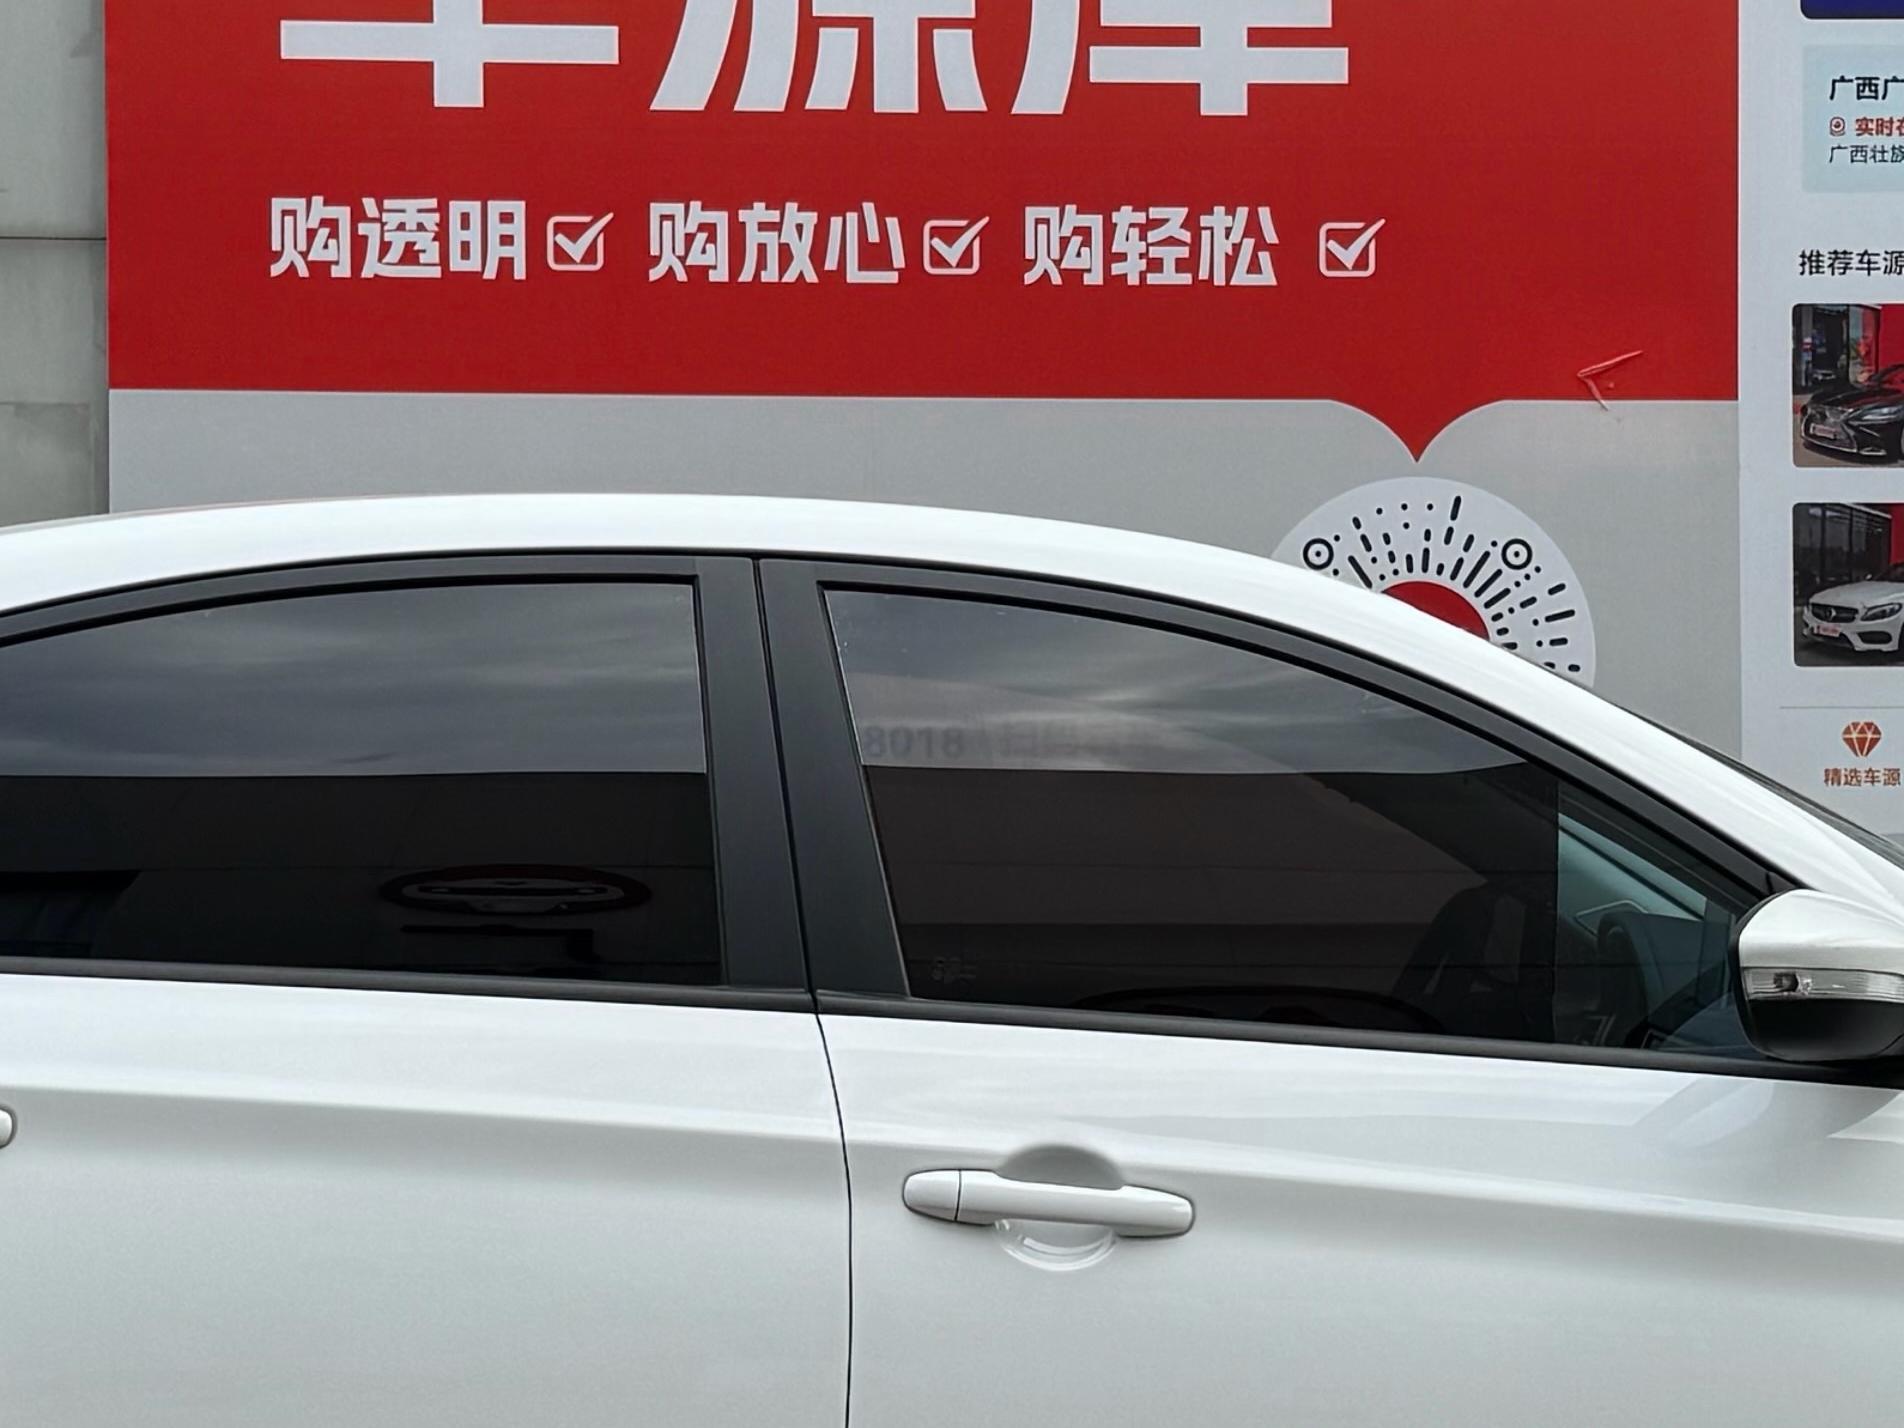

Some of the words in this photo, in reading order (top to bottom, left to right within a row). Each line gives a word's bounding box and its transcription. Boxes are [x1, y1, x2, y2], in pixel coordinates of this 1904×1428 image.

[269, 196, 528, 281] 购透明
[647, 200, 905, 286] 购放心
[1022, 203, 1279, 288] 购轻松
[1824, 768, 1900, 786] 精选车源
